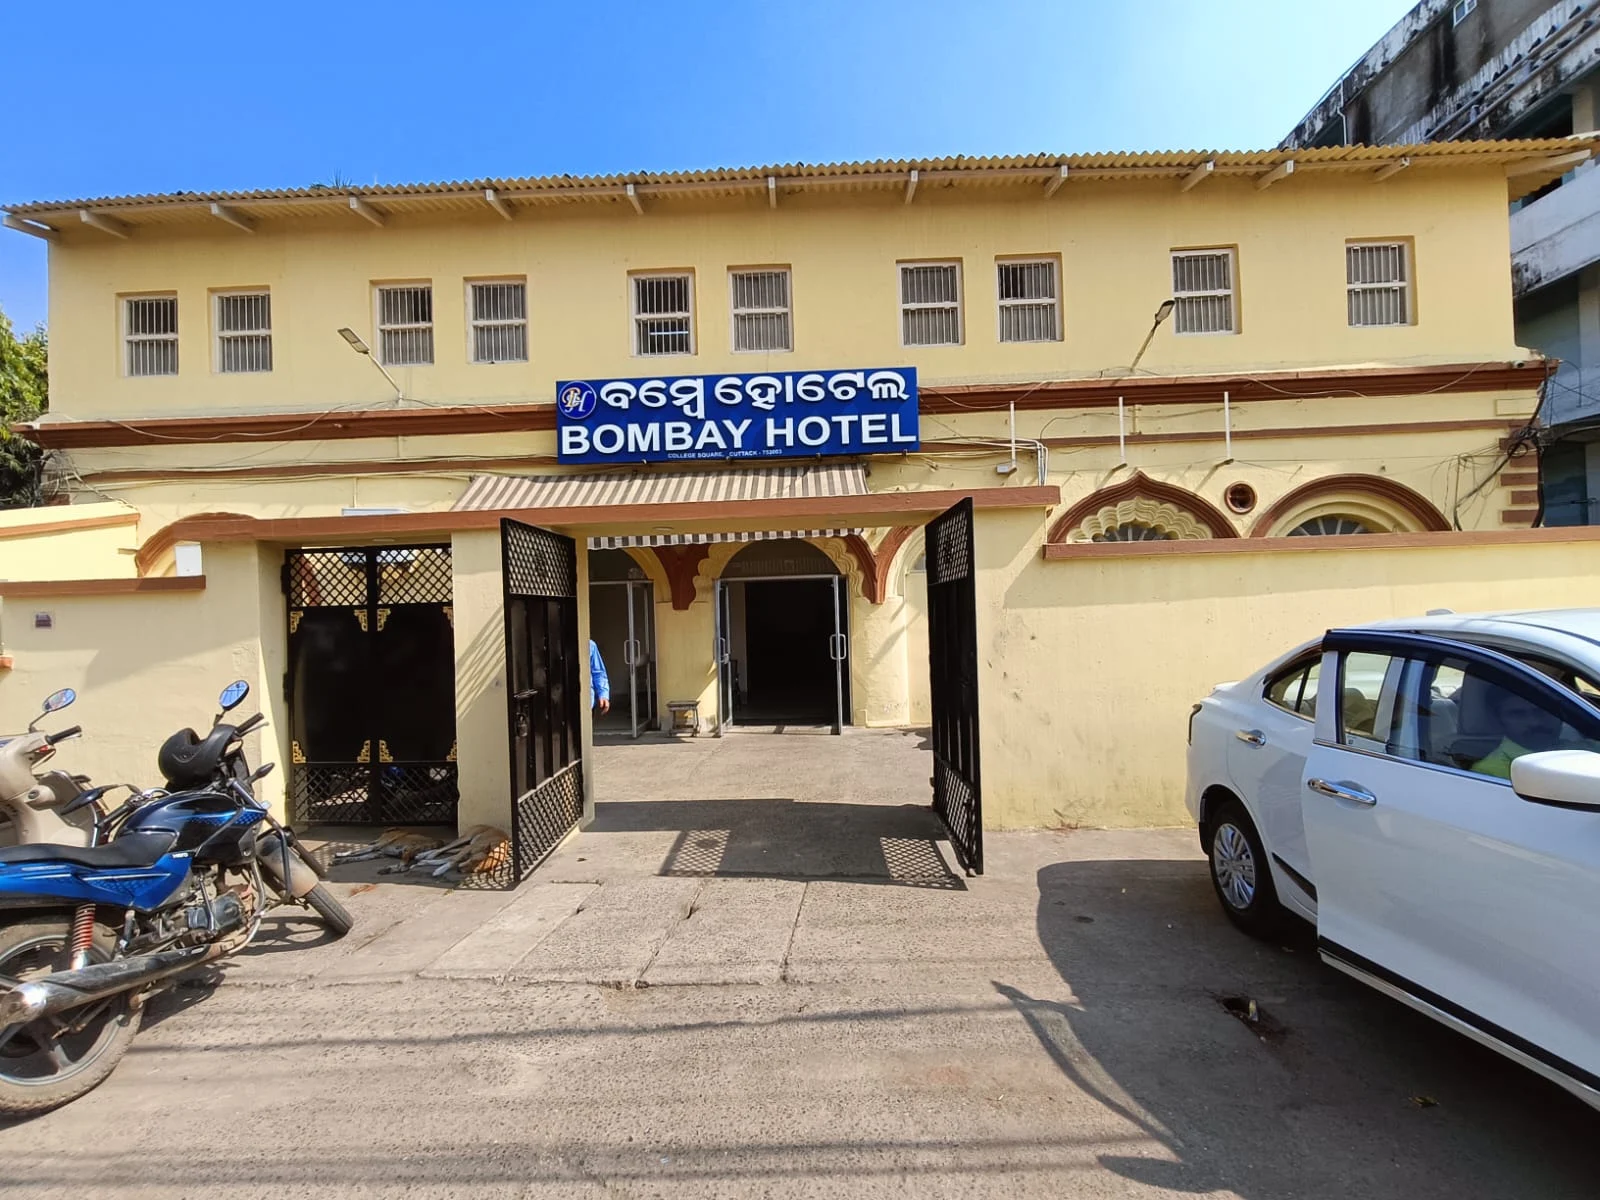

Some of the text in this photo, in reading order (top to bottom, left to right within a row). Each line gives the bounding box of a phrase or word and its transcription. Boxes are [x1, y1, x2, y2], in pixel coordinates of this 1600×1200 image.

[715, 371, 909, 410] ହୋଟେଲ
[562, 413, 917, 455] BOMBAY HOTEL
